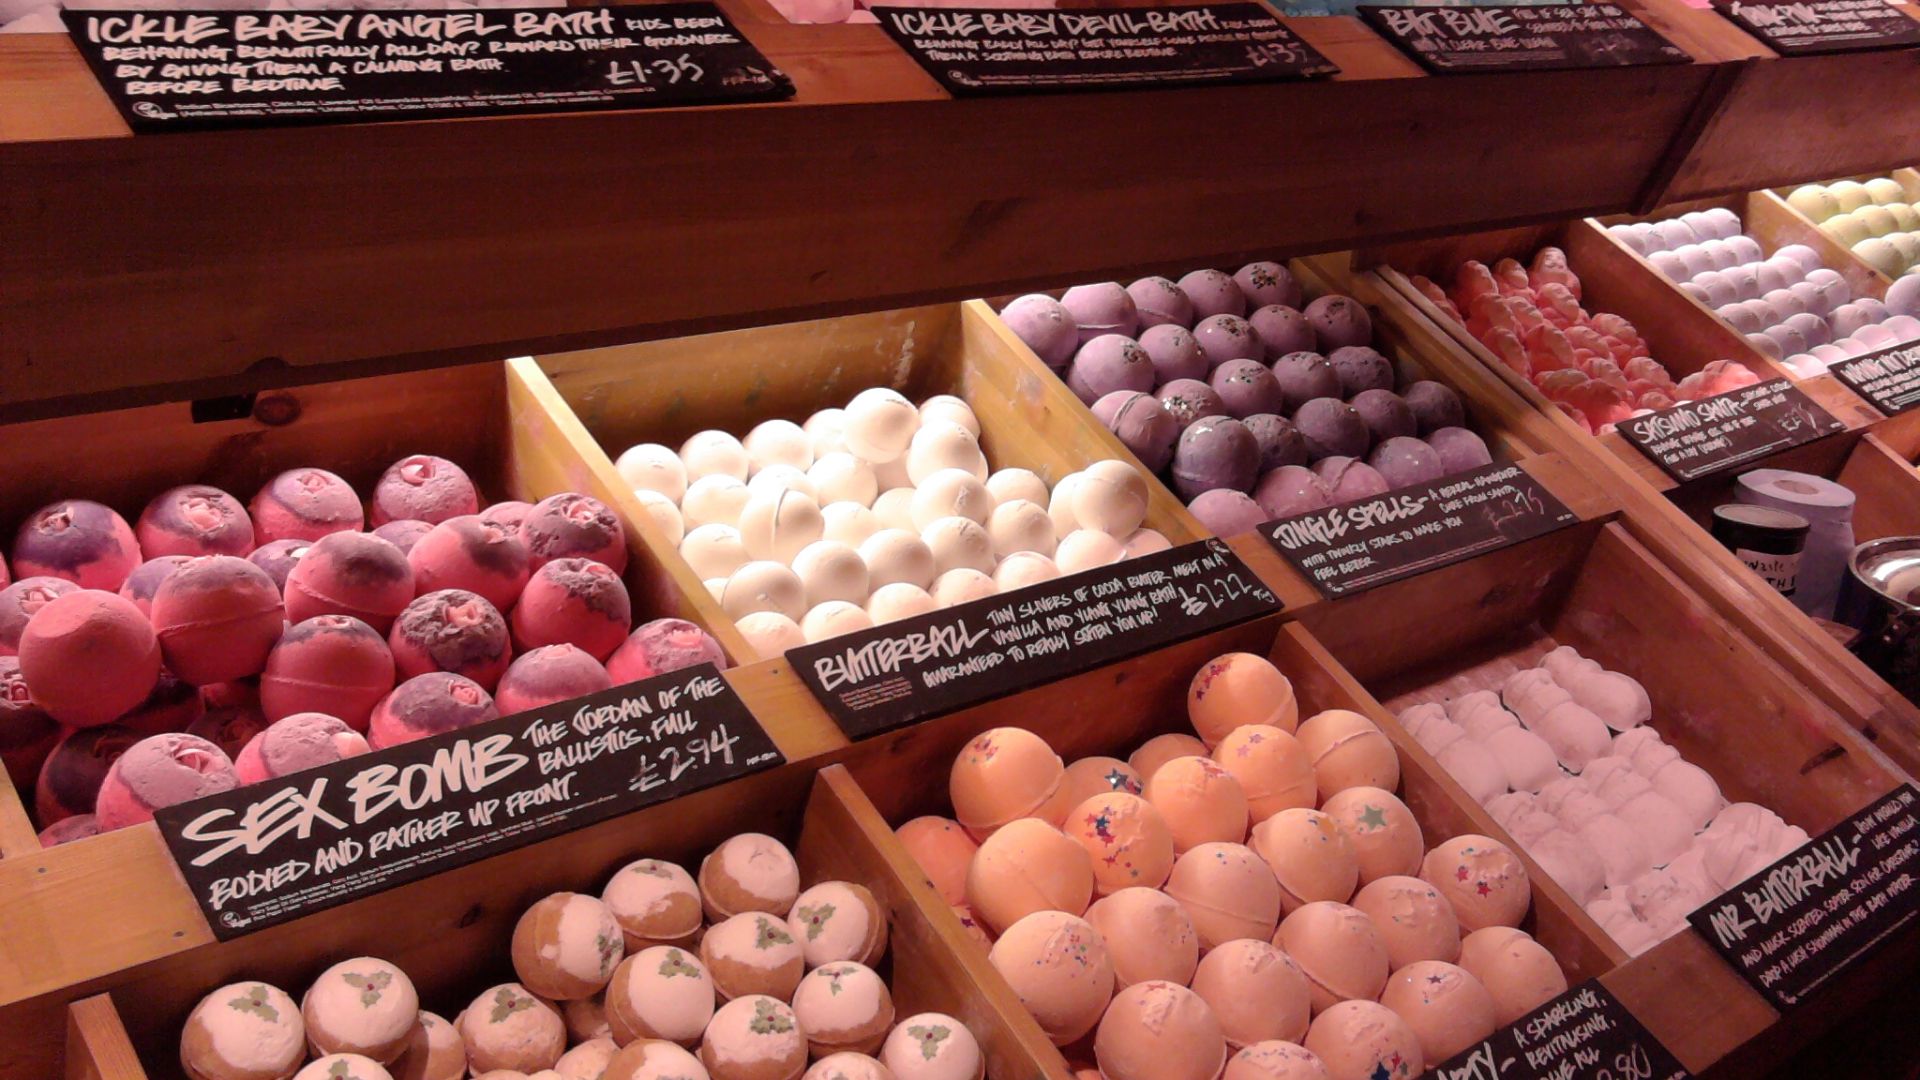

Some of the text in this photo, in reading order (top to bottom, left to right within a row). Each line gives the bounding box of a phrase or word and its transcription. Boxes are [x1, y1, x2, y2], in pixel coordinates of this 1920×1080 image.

[88, 9, 725, 43] ICKLE BABY ANGEL BATH KIDS BEEN
[891, 12, 983, 37] ICKLE
[981, 12, 1058, 36] BABY
[1059, 11, 1149, 36] DEVIL
[1146, 8, 1220, 33] BATH
[1438, 8, 1521, 36] BLUE
[103, 45, 233, 61] BEHAVING
[236, 43, 379, 60] BEAUTIFULLY
[385, 43, 427, 57] ALL
[489, 39, 574, 54] REWARD
[575, 37, 637, 51] THEIR
[643, 33, 741, 49] GOODNESS
[116, 64, 154, 79] BY
[161, 62, 249, 77] GIVING
[249, 61, 323, 76] THEM
[328, 61, 347, 75] A
[353, 59, 444, 74] CALMING
[126, 80, 225, 95] BEFORE
[1272, 507, 1350, 550] JINGLE
[1314, 567, 1339, 582] FEEL
[814, 619, 990, 692] BUTTERBALL
[986, 603, 1015, 627] TINY
[1018, 592, 1073, 620] SLIVERS
[1073, 585, 1091, 603] OF
[1092, 576, 1126, 597] COCOA
[1126, 568, 1173, 590] BUTTER
[1172, 558, 1201, 579] MELT
[1213, 552, 1229, 568] A
[991, 616, 1045, 647] VANILLA
[1047, 610, 1074, 631] AND
[1076, 600, 1114, 626] YLANG
[1112, 590, 1151, 617] YLANG
[921, 652, 1004, 689] GUARANTEED
[1007, 646, 1026, 664] TO
[1025, 630, 1071, 658] REALLY
[1113, 614, 1139, 633] YOU
[651, 710, 699, 740] FULL
[181, 777, 349, 867] SEX
[346, 733, 530, 825] BOMB
[521, 718, 569, 749] THE
[572, 694, 653, 737] JORDAN
[658, 686, 681, 708] OF
[683, 675, 726, 702] THE
[208, 859, 310, 911] BODIED
[315, 837, 364, 876] AND
[368, 810, 464, 860] RATHER
[469, 798, 501, 828] UP
[505, 770, 580, 818] FRONT.
[1709, 902, 1758, 950] MR
[1513, 1026, 1530, 1050] A
